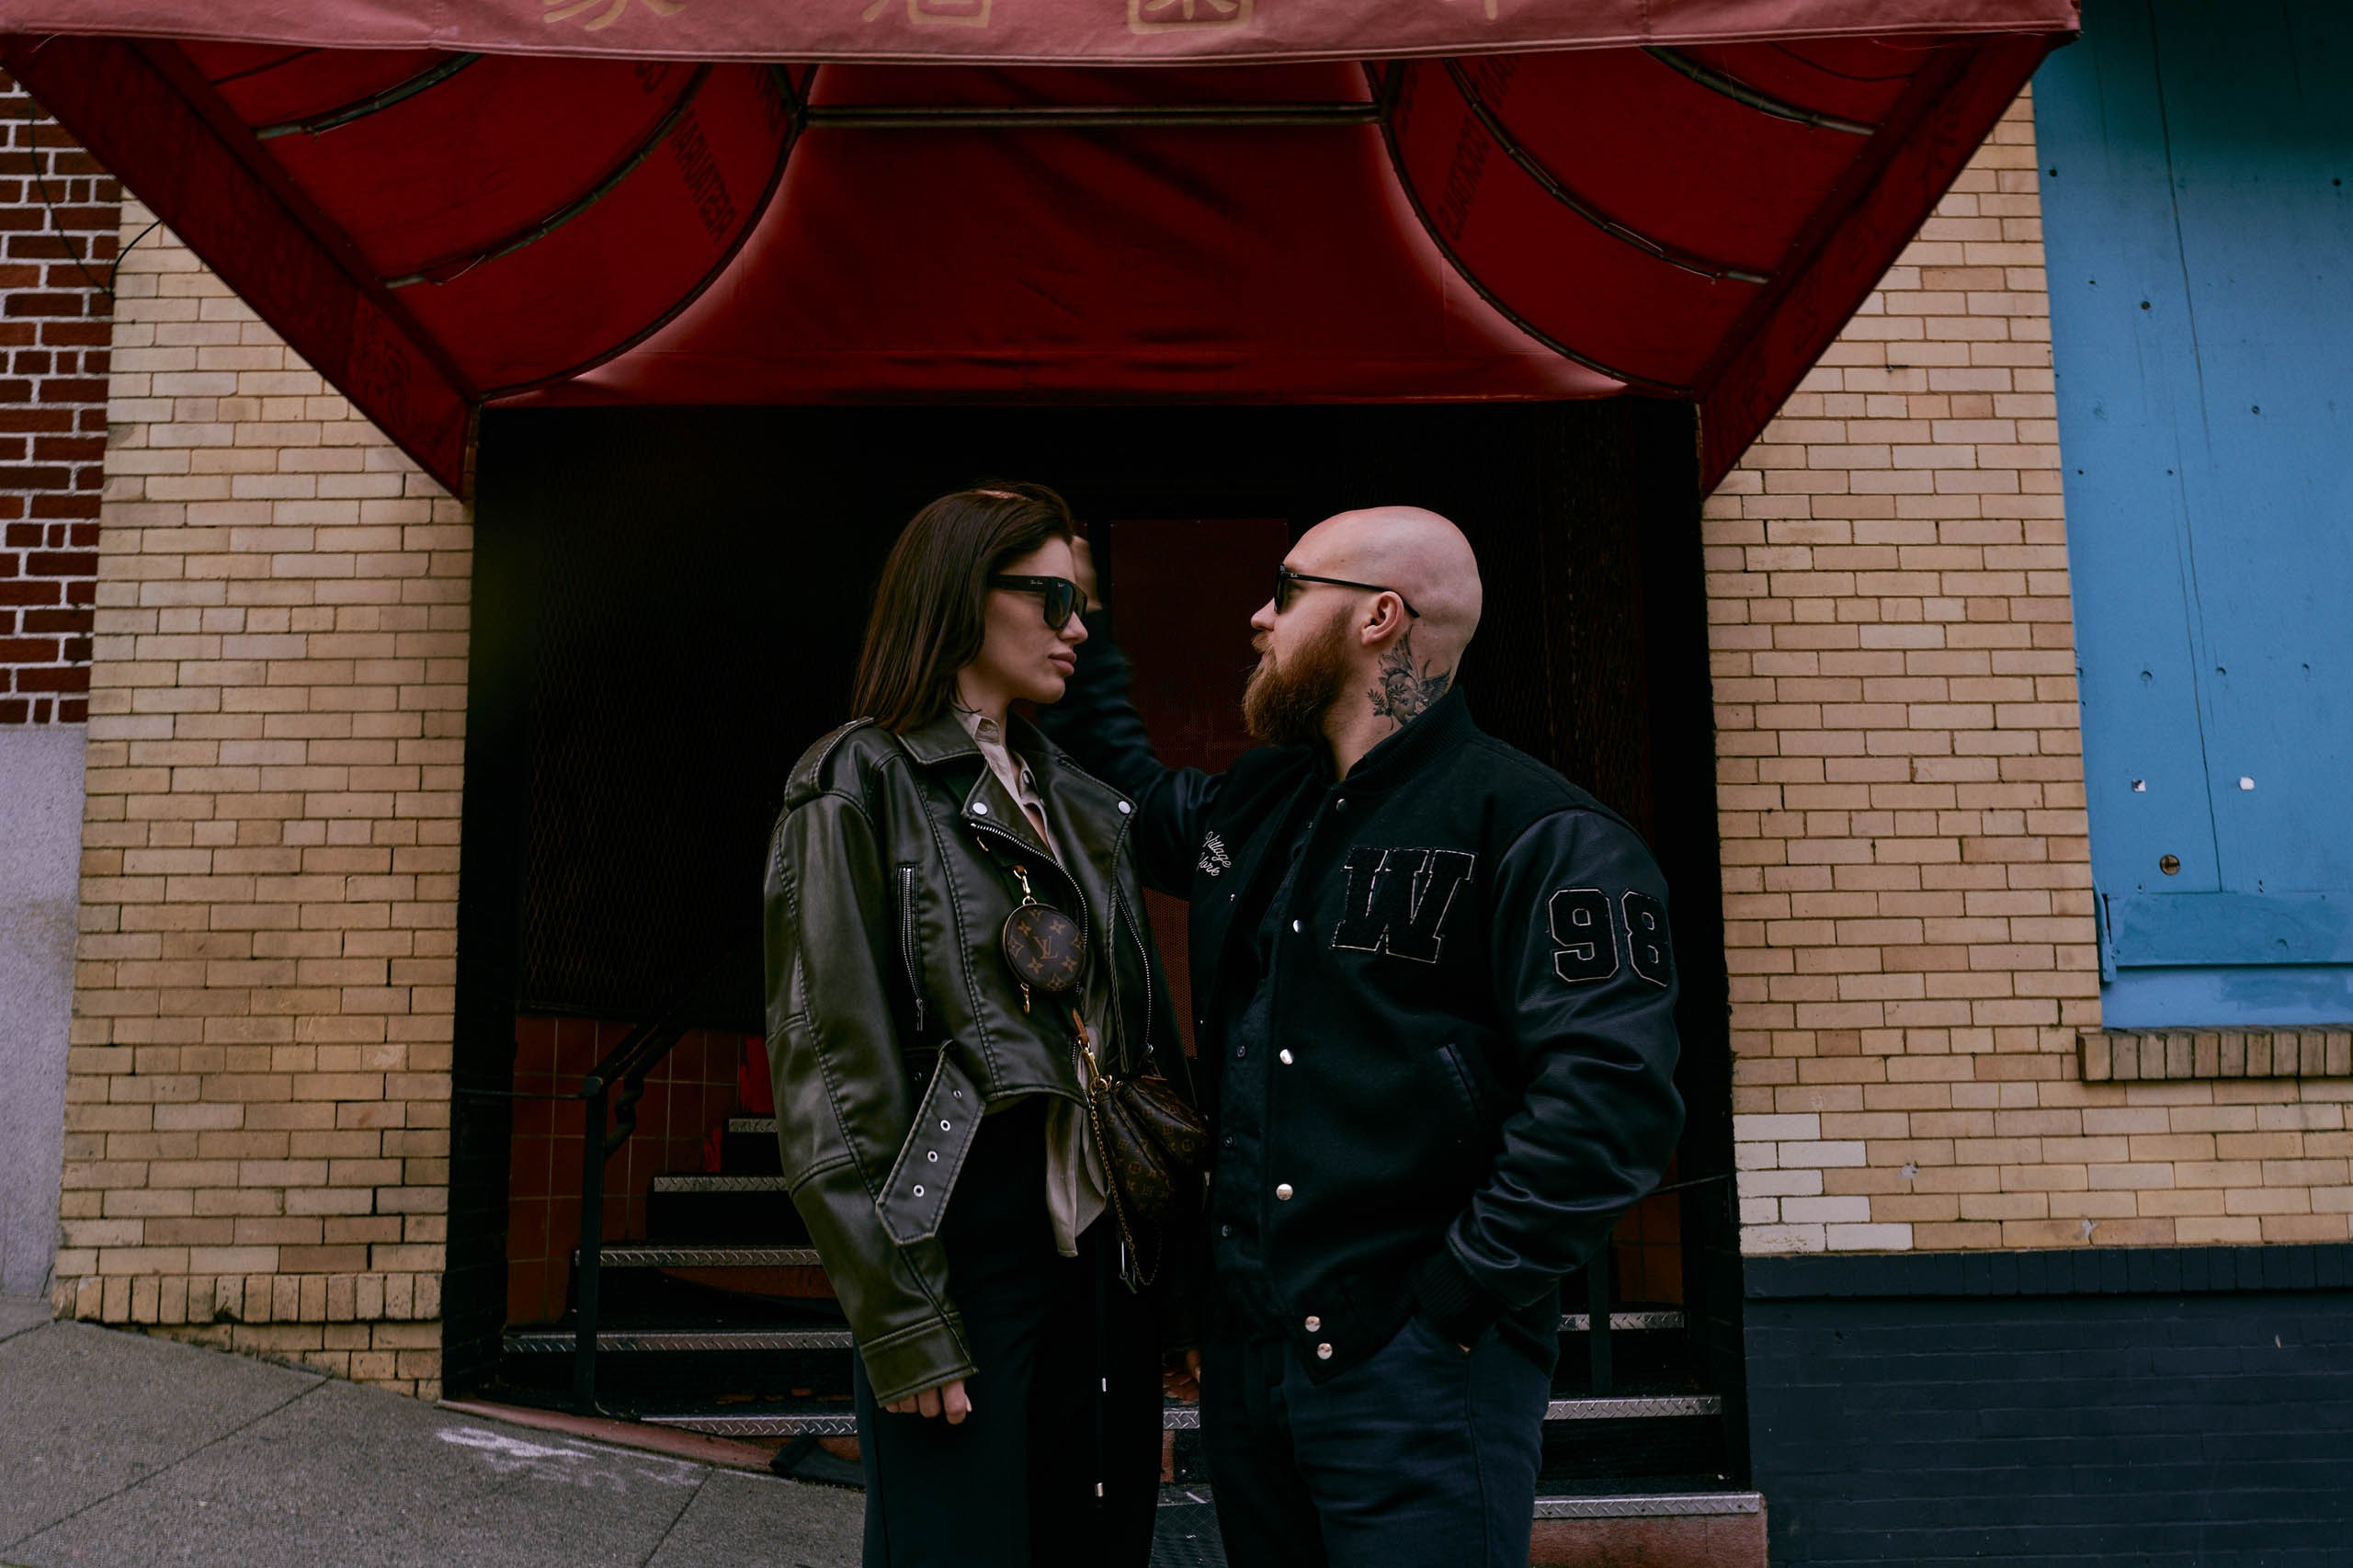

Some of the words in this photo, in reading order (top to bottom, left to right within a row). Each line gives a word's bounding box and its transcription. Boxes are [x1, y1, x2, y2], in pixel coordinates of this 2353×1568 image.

[1202, 830, 1233, 868] Village
[1329, 846, 1479, 965] W
[1545, 886, 1672, 988] 98
